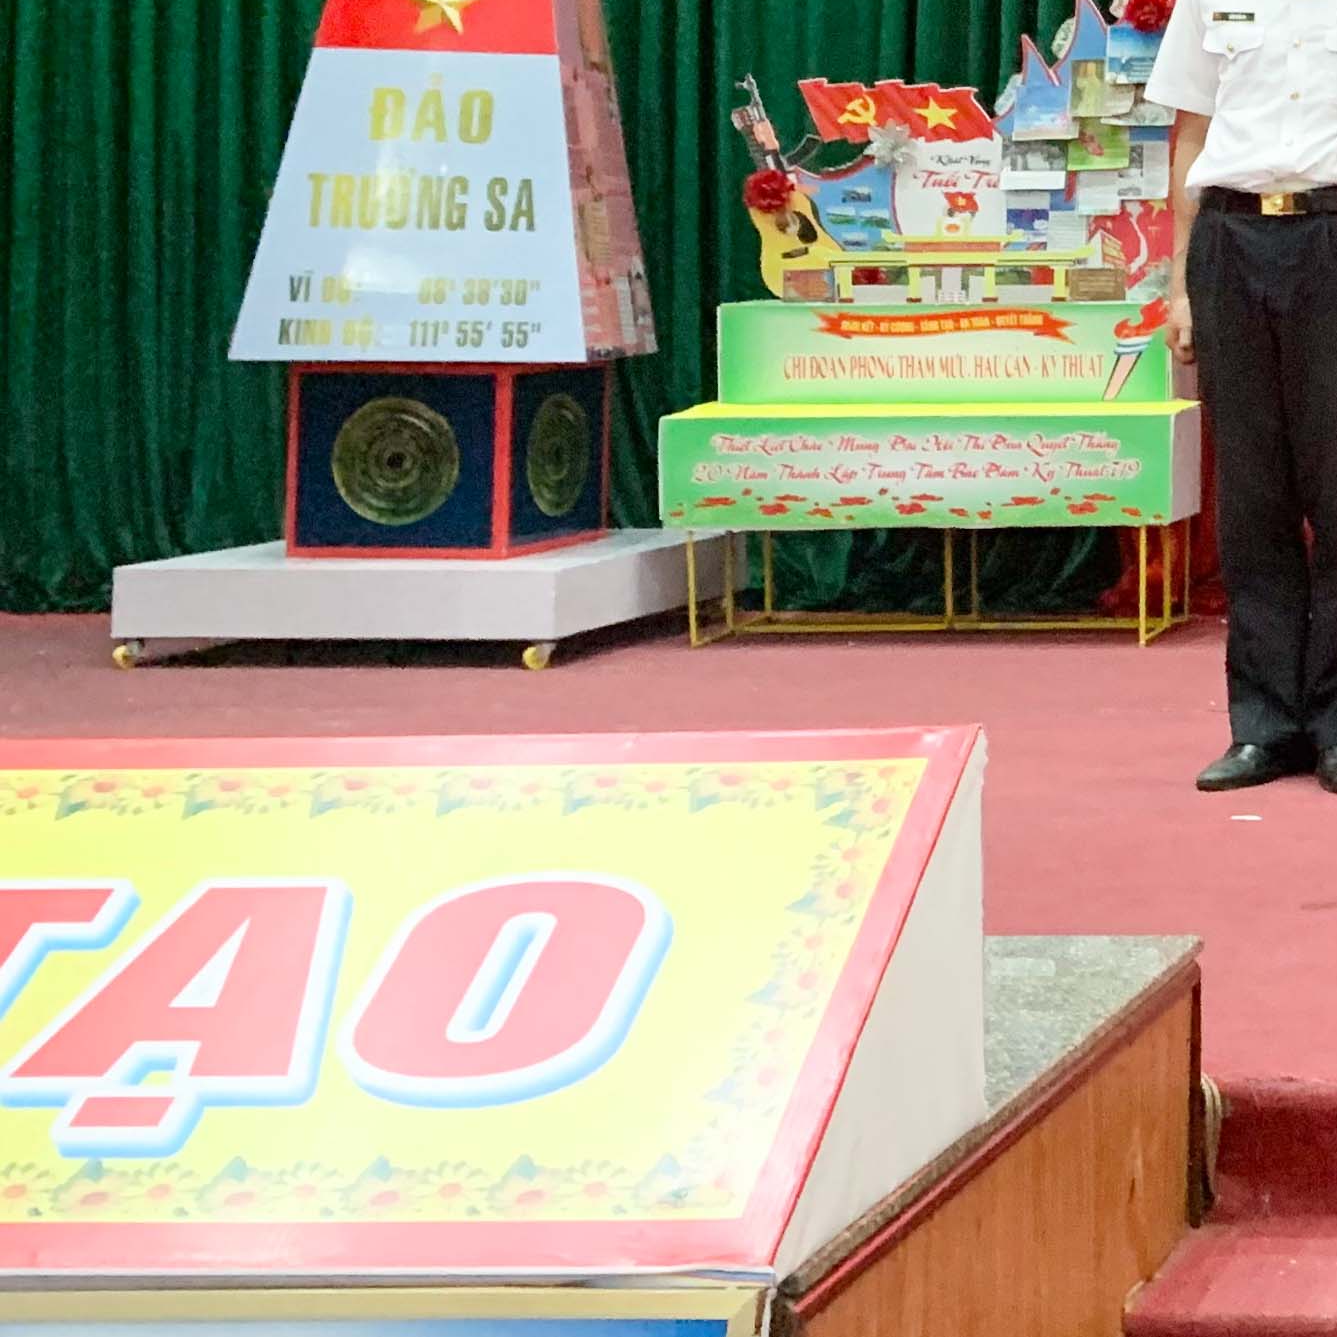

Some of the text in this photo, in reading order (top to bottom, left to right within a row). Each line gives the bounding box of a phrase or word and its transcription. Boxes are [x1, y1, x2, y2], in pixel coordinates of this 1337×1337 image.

[367, 73, 494, 146] ĐẢO
[483, 174, 536, 233] SA
[288, 270, 314, 302] VĨ
[277, 317, 332, 347] KINH
